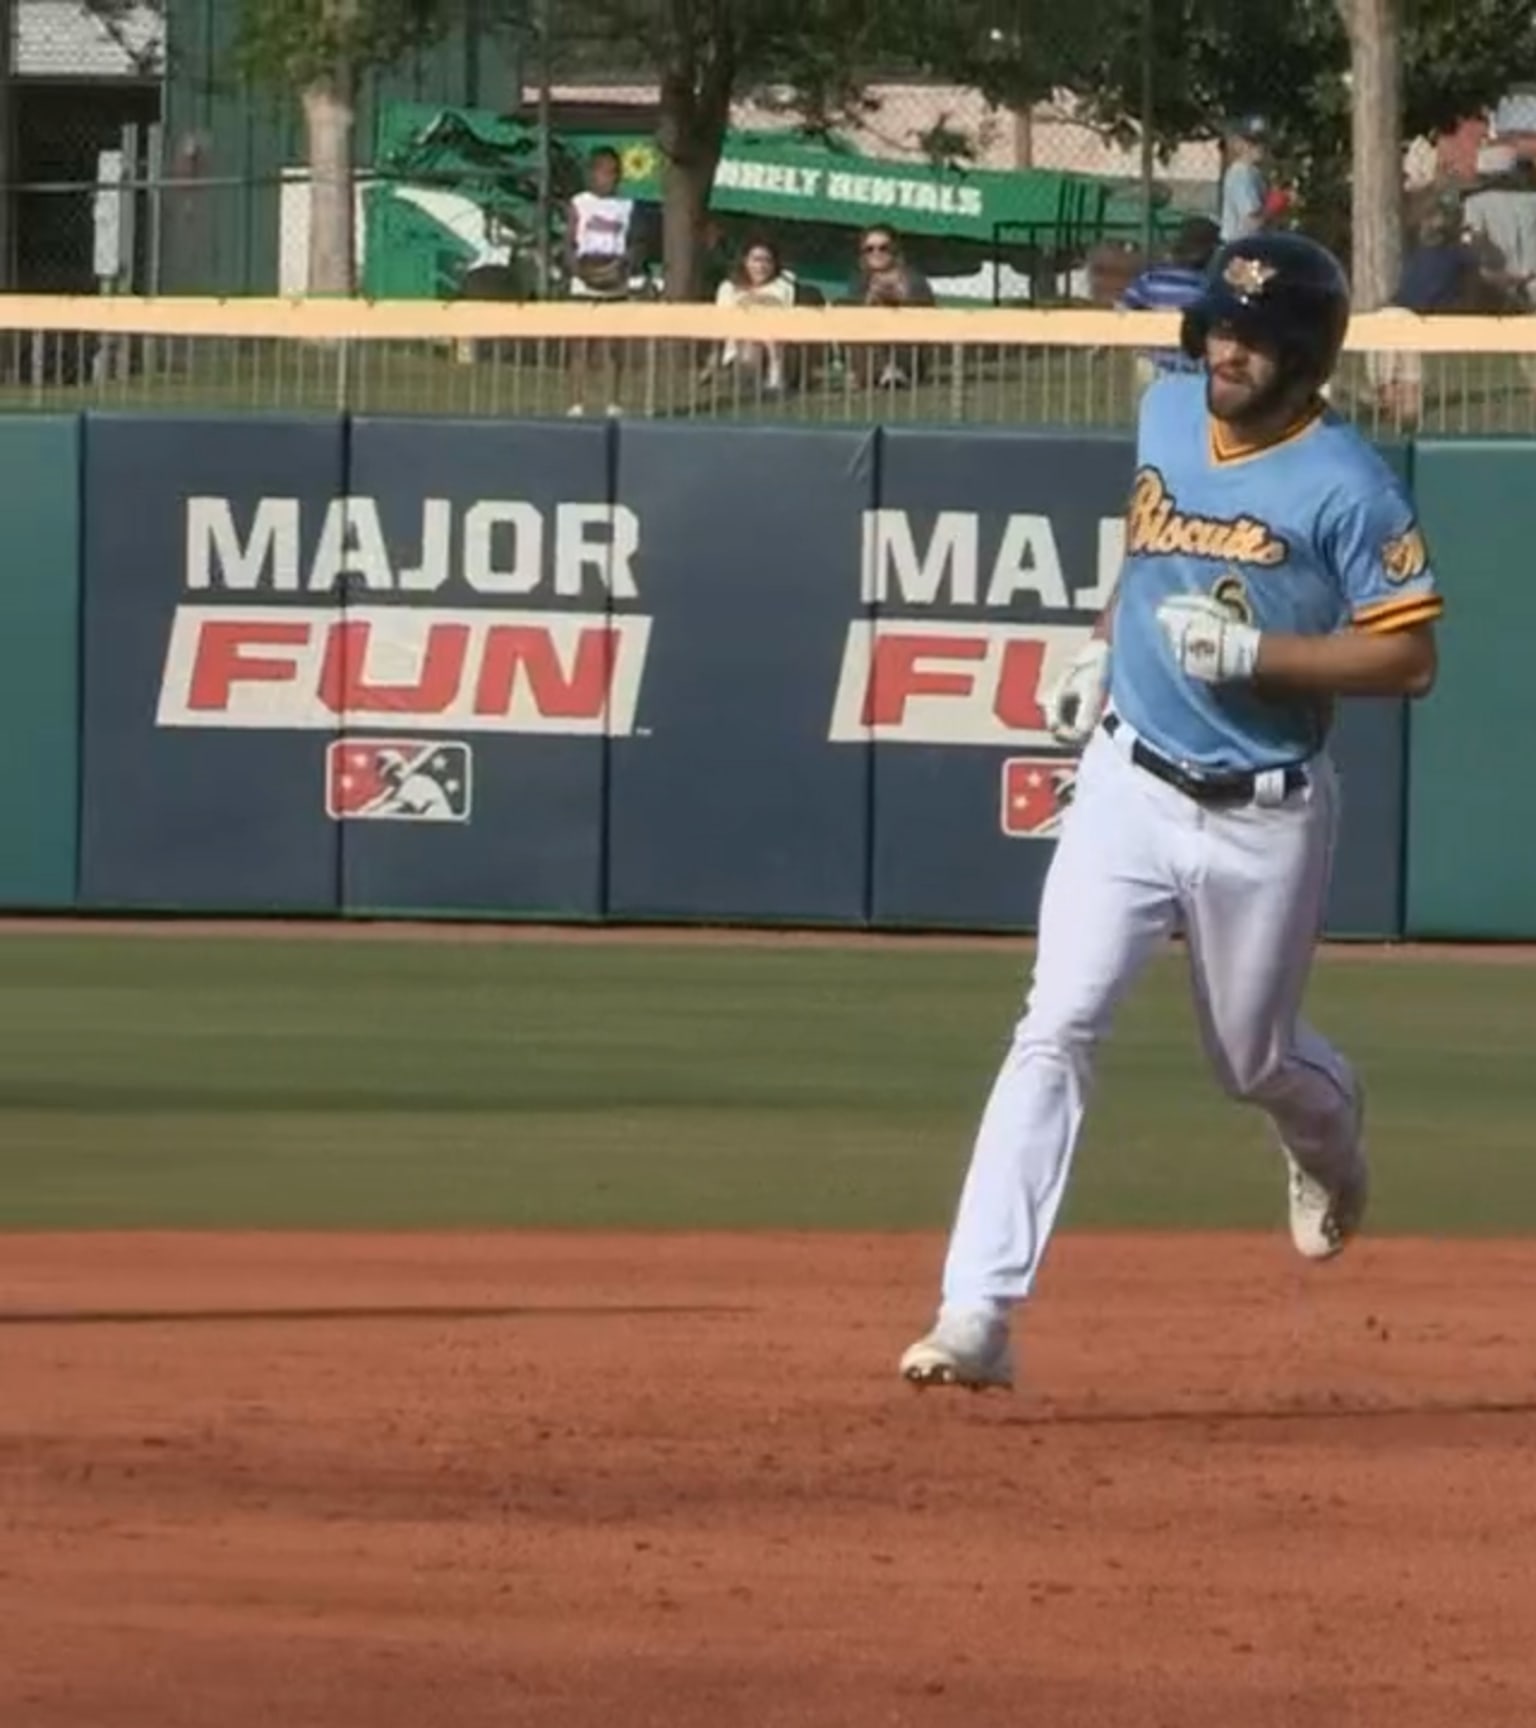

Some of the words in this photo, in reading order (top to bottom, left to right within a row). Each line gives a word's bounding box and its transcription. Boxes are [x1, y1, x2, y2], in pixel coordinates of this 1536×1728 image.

[826, 169, 982, 217] RENTALS
[187, 496, 640, 598] MAJOR
[861, 508, 1127, 611] MAJ
[188, 620, 620, 719] FUN
